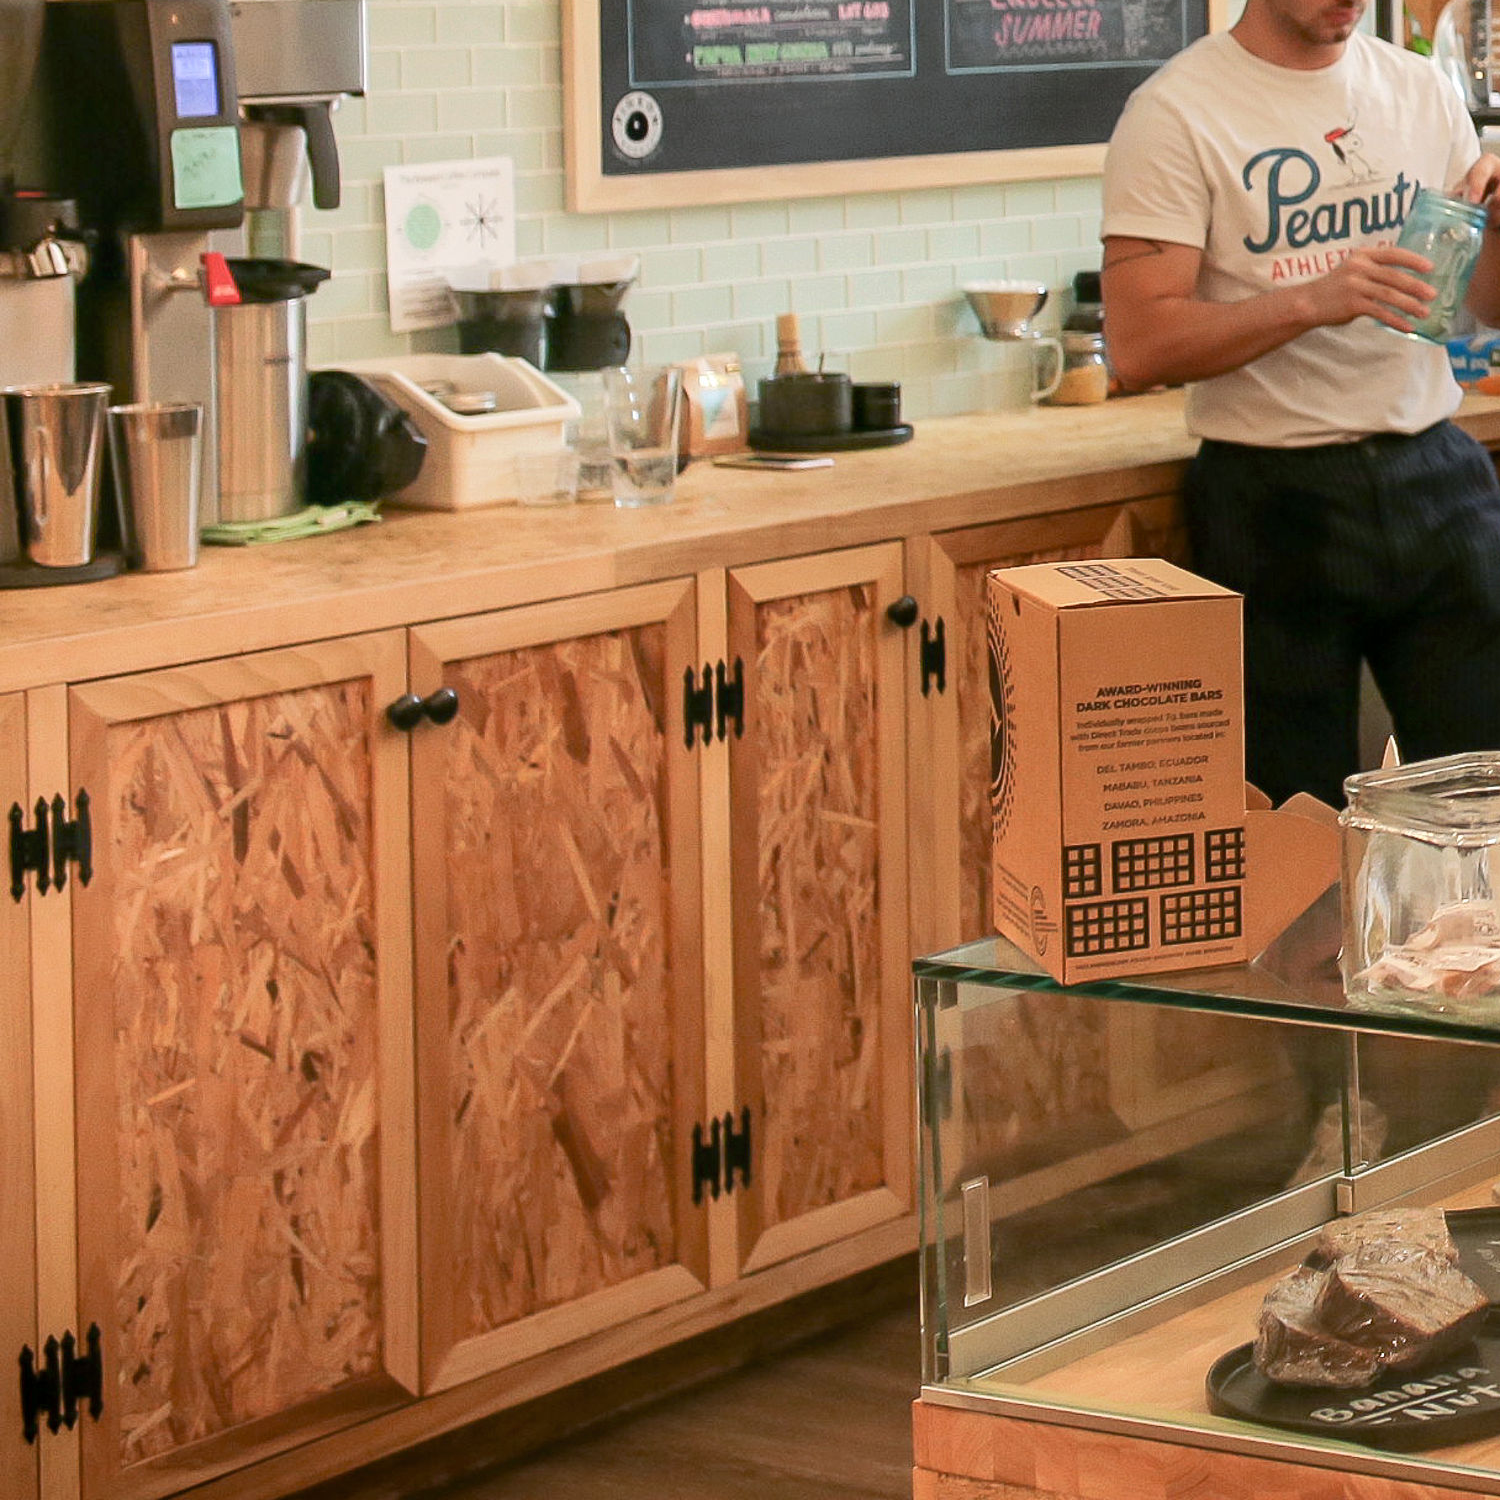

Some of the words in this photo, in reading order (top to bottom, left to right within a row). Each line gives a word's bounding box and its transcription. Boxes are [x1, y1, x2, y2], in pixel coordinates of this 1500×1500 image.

[995, 10, 1102, 47] SUMMER
[1096, 679, 1202, 698] AWARD-WINNING
[1076, 701, 1111, 713] DARK
[1114, 693, 1188, 709] CHOCOLATE
[1190, 689, 1224, 701] BARS
[1076, 718, 1125, 730] Individually
[1124, 715, 1164, 727] wrapped
[1198, 708, 1224, 717] made
[1069, 732, 1090, 741] with
[1091, 730, 1117, 739] Direct
[1119, 728, 1142, 737] Trade
[1170, 723, 1195, 732] beans
[1196, 719, 1230, 729] sourced
[1078, 743, 1099, 752] from
[1100, 742, 1115, 750] our
[1116, 739, 1145, 748] farmer
[1146, 736, 1182, 747] partners
[1182, 732, 1214, 743] located
[1096, 764, 1117, 774] DEL
[1159, 755, 1209, 768] ECUADOR
[1153, 774, 1203, 787] TANZANIA
[1104, 801, 1142, 812] DAVAO,
[1143, 793, 1204, 807] PHILIPPINES
[1151, 812, 1206, 826] AMAZONIA
[1309, 1366, 1491, 1424] Banana
